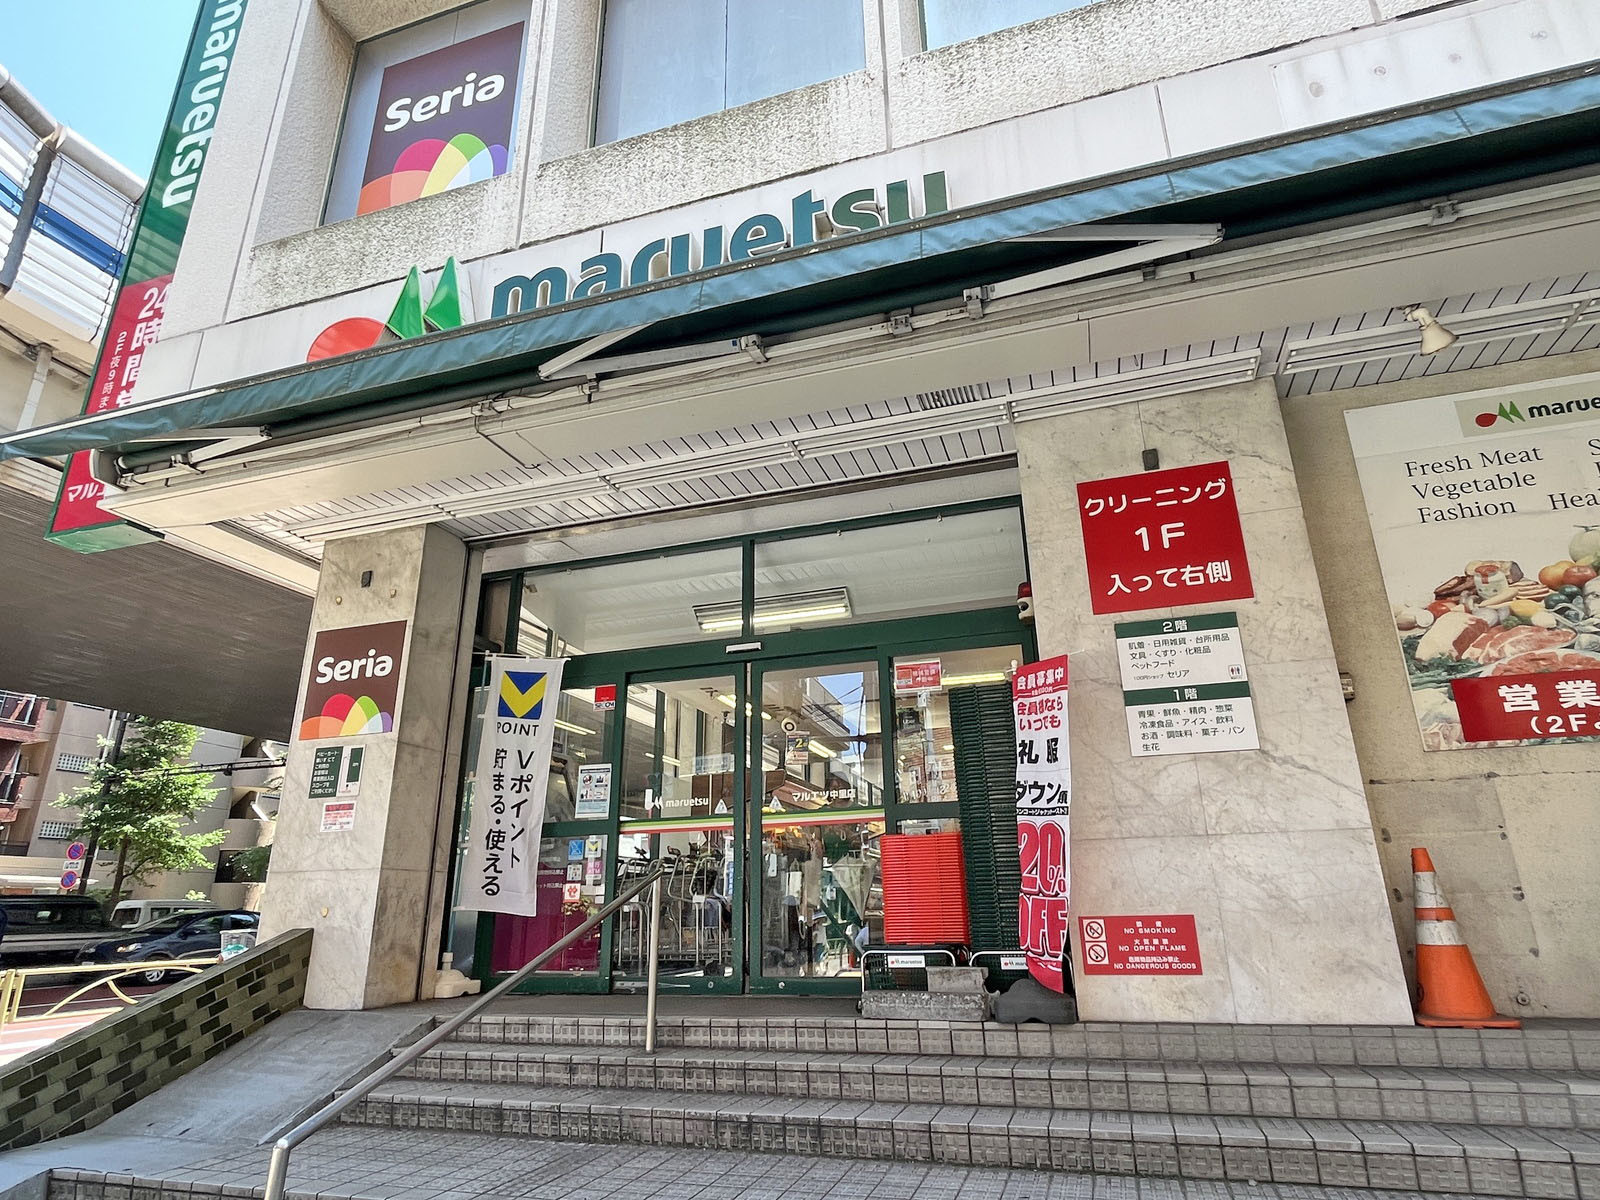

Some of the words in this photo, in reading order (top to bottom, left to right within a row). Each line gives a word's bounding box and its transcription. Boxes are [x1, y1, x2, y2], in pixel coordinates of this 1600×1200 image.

[384, 72, 505, 132] Seria
[491, 171, 948, 318] maruetsu
[97, 331, 128, 413] 2F夜9時ま
[1405, 456, 1472, 477] Fresh
[1479, 448, 1543, 467] Meat
[1085, 478, 1226, 516] クリーニング
[1411, 472, 1537, 500] Vegetable
[1547, 491, 1600, 510] Hea
[1417, 501, 1517, 523] Fashion
[1135, 522, 1185, 551] 1F
[1107, 560, 1232, 595] 入って右側
[1162, 620, 1188, 632] 2階
[1130, 646, 1211, 660] 文具・くすり・化粧品
[316, 649, 393, 684] Seria
[1131, 660, 1175, 669] ペットフード
[1167, 669, 1190, 679] セリア
[1173, 688, 1198, 701] 1階
[497, 721, 539, 737] POINT
[1139, 716, 1234, 729] 冷凍食品・アイス・飲料
[1141, 727, 1245, 740] お酒・調味料・菓子・パン
[1142, 743, 1160, 751] 生花
[510, 750, 535, 868] Vポイント
[665, 796, 709, 808] maruetsu
[481, 748, 507, 896] 貯まる・使える
